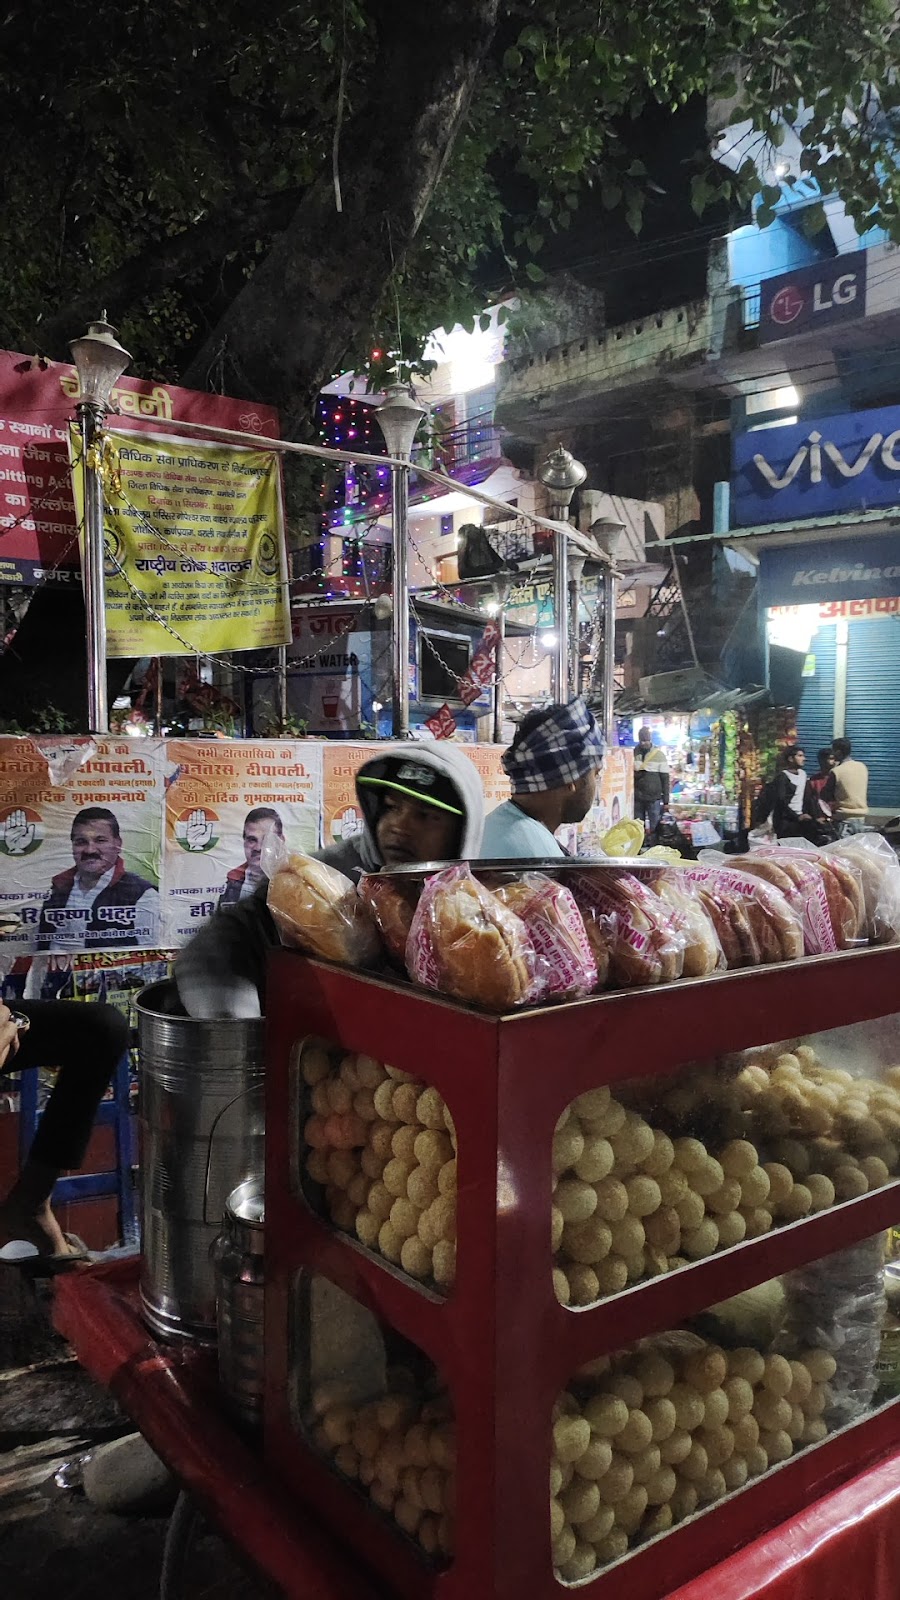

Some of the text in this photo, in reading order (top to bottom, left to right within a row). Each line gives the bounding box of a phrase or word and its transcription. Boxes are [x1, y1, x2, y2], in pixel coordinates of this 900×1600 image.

[813, 274, 857, 312] LG
[135, 555, 177, 576] राष्ट्रीय
[320, 651, 360, 668] WATER
